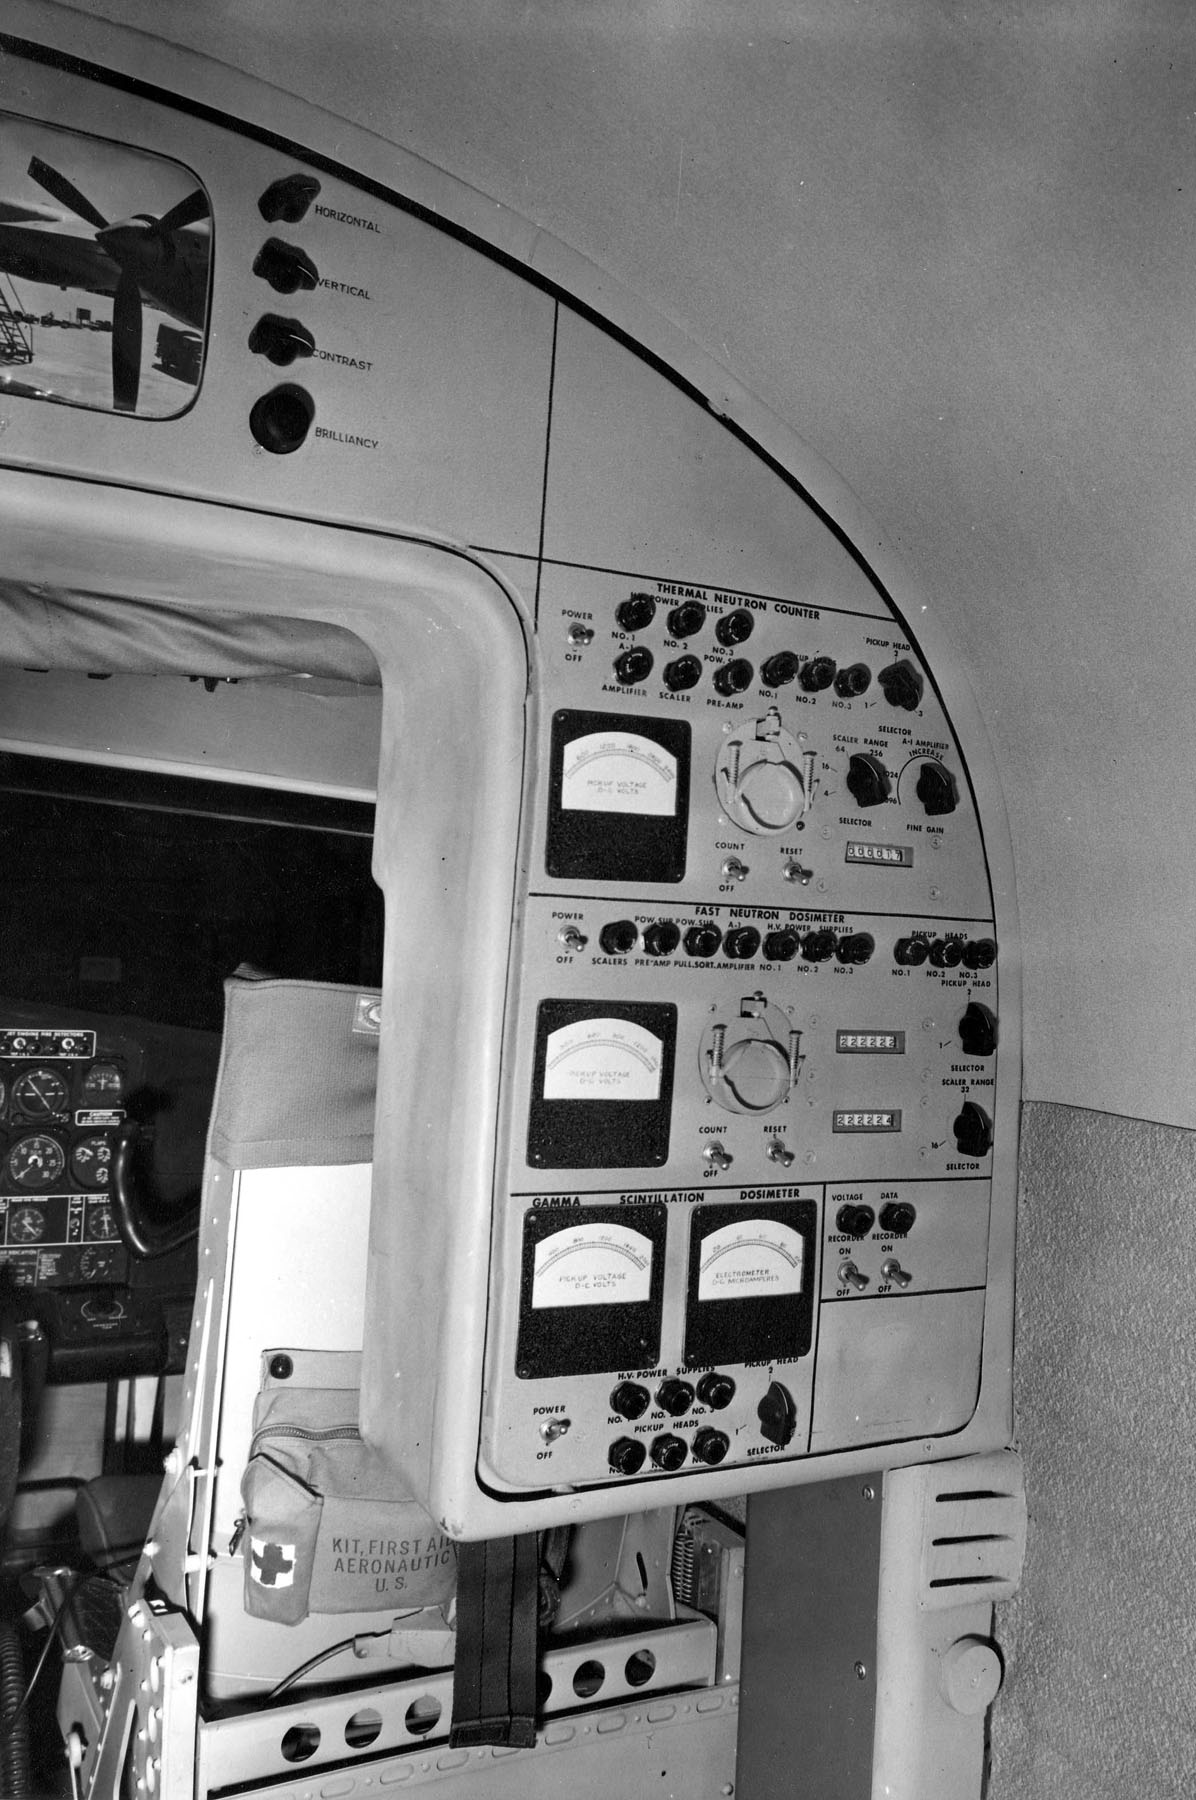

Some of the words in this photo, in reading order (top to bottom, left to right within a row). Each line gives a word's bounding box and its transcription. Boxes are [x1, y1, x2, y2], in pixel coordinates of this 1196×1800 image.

[315, 204, 381, 233] HORIZONTAL
[316, 278, 371, 300] VERTICAL
[312, 349, 373, 371] CONTRAST
[315, 426, 379, 449] BRILLIANCY
[651, 595, 680, 606] POWER
[657, 583, 708, 600] THERMAL
[714, 593, 767, 611] NEUTRON
[774, 603, 820, 620] COUNTER
[562, 609, 593, 620] POWER
[866, 637, 889, 648] PICKUP
[893, 642, 911, 651] HEAD
[565, 654, 582, 662] OFF
[602, 684, 647, 697] AMPLIFIER
[659, 691, 691, 702] SCALER
[706, 698, 744, 710] PRE-AMP
[878, 725, 912, 736] SELECTOR
[833, 734, 859, 744] SCALER
[864, 738, 888, 748] RANGE
[915, 740, 949, 750] AMPLIFIER
[869, 749, 883, 757] 256
[909, 748, 944, 761] INCREASE
[839, 817, 872, 827] SELECTOR
[906, 824, 922, 832] FINE
[926, 826, 944, 834] GAIN
[715, 841, 745, 850] COUNT
[781, 847, 803, 855] RESET
[719, 884, 735, 892] OFF
[552, 912, 584, 920] POWER
[695, 907, 721, 917] FAST
[729, 908, 780, 920] NEUTRON
[789, 912, 845, 923] DOSIMETER
[785, 923, 811, 932] POWER
[819, 926, 853, 934] SUPPLIES
[912, 930, 937, 938] PICKUP
[945, 932, 968, 940] HEADS
[556, 956, 573, 964] OFF
[592, 957, 628, 965] SCALERS
[941, 979, 967, 987] PICKUP
[972, 980, 991, 988] HEAD
[951, 1064, 985, 1072] SELECTOR
[699, 1126, 728, 1134] COUNT
[764, 1125, 787, 1133] RESET
[946, 1163, 980, 1171] SELECTOR
[532, 1197, 581, 1208] GAMMA
[620, 1191, 704, 1205] SCINTILLATION
[740, 1188, 800, 1200] DOSIMETER
[832, 1193, 863, 1201] VOLTAGE
[881, 1192, 898, 1200] DATA
[828, 1234, 864, 1243] RECORDER
[872, 1232, 908, 1240] RECORDER
[839, 1247, 851, 1255] ON
[836, 1289, 850, 1297] OFF
[878, 1285, 892, 1293] OFF
[745, 1360, 771, 1368] PICKUP
[777, 1357, 799, 1365] HEAD
[637, 1369, 668, 1379] POWER
[676, 1366, 715, 1375] SUPPLIES
[533, 1405, 566, 1415] POWER
[634, 1424, 664, 1433] PICKUP
[673, 1420, 699, 1429] HEADS
[747, 1444, 785, 1456] SELECTOR
[536, 1452, 552, 1460] OFF
[369, 1539, 421, 1555] FIRST
